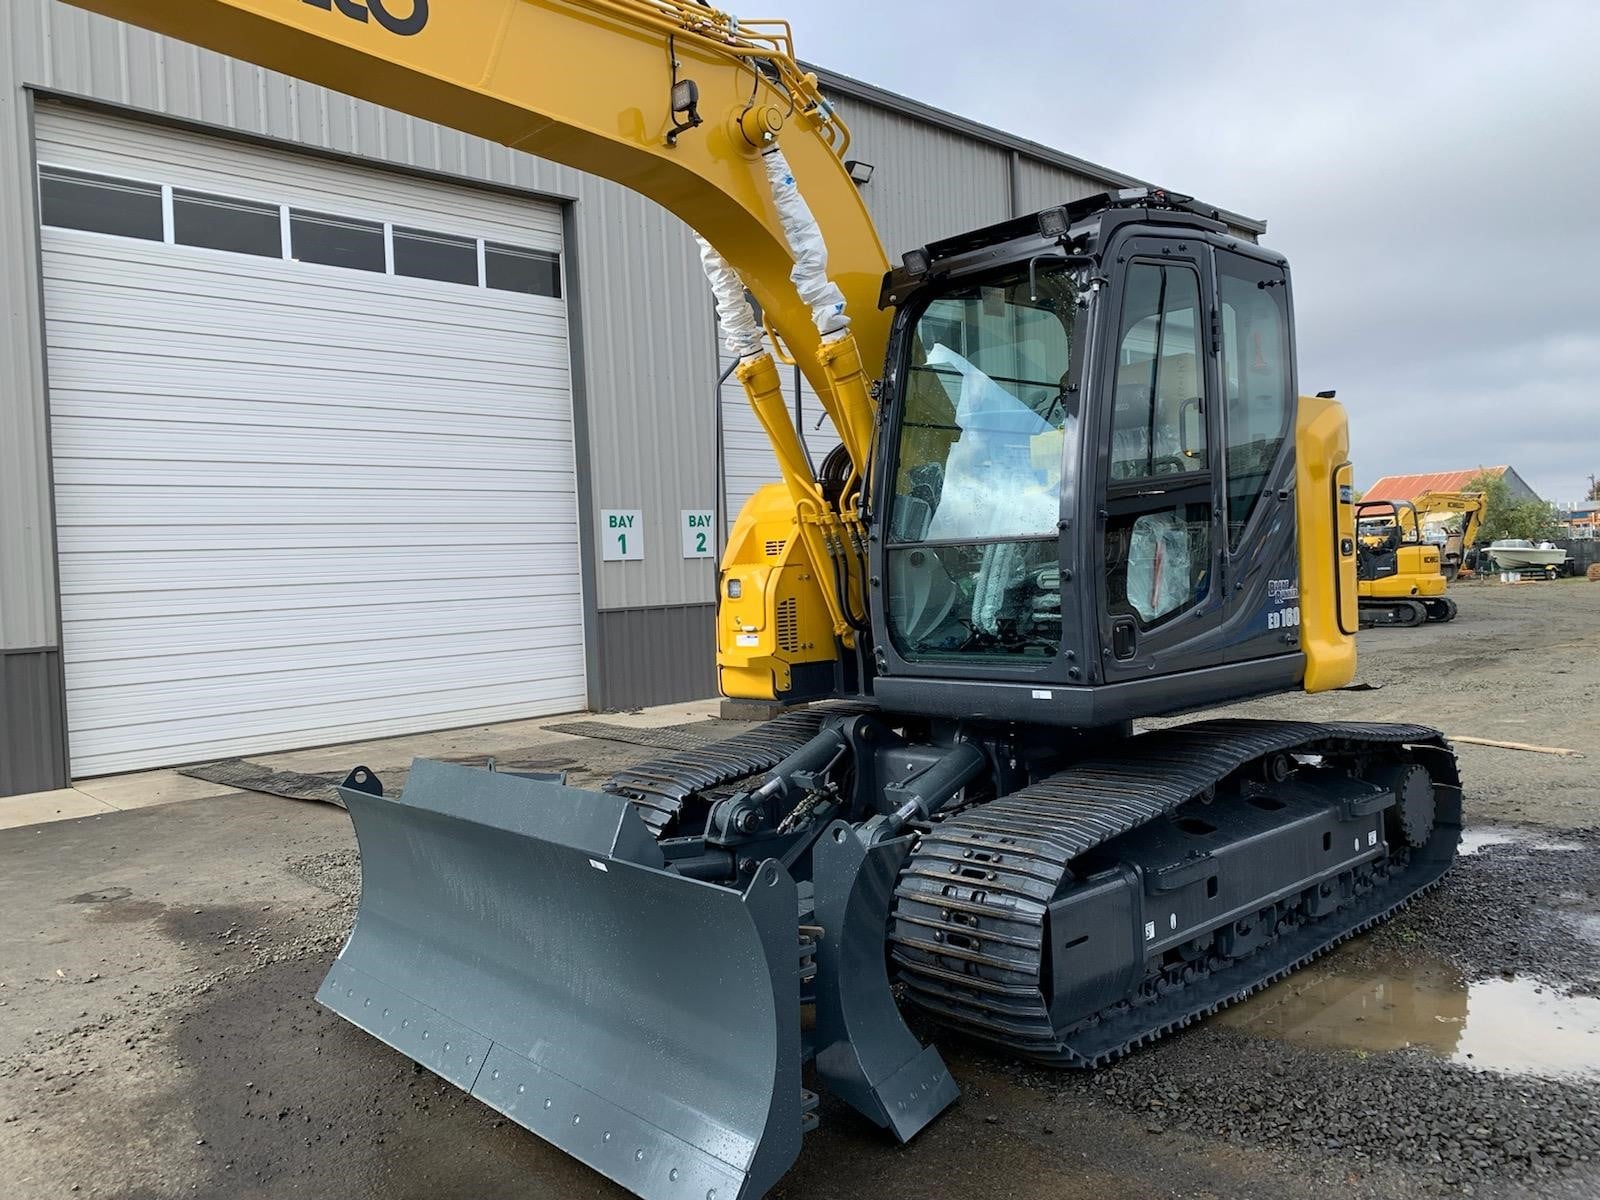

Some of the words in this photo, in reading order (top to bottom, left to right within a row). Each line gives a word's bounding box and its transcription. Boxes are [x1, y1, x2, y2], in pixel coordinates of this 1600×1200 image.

[609, 515, 634, 528] BAY
[689, 515, 711, 527] BAY
[618, 534, 626, 554] 1
[696, 532, 706, 552] 2
